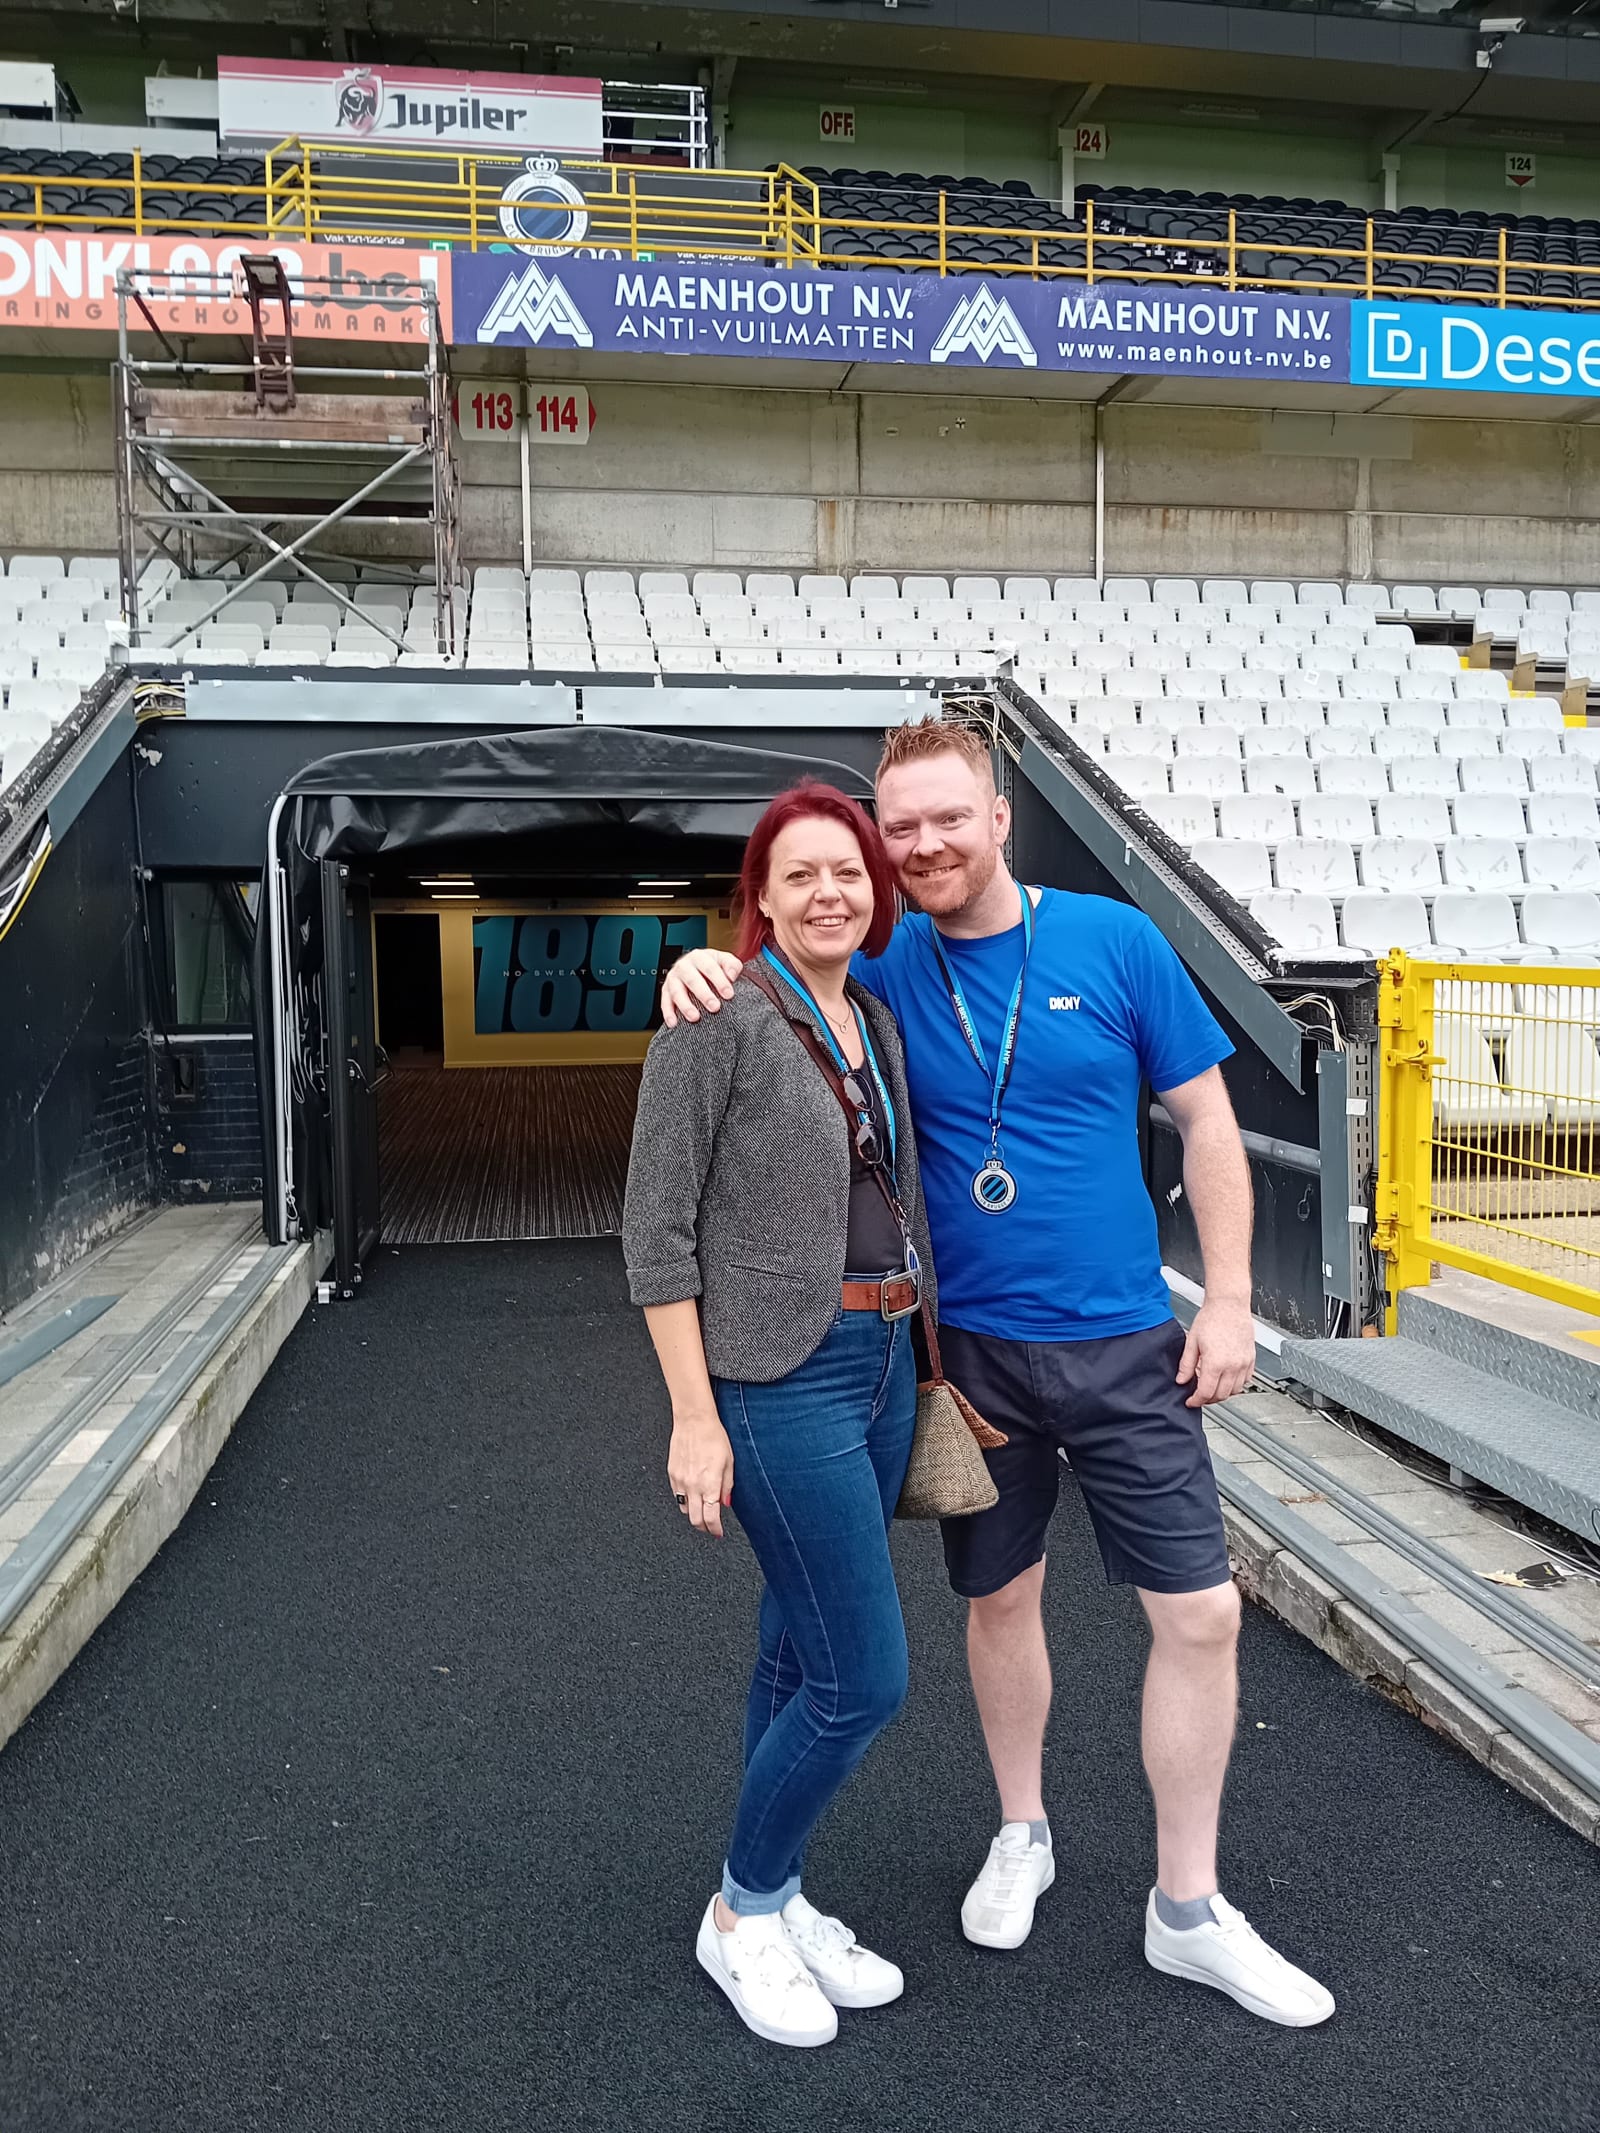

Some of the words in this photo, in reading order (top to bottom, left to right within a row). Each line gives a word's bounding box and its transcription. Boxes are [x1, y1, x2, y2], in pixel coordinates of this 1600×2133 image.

[384, 94, 527, 136] Jupiler
[1509, 157, 1532, 171] 124
[614, 273, 834, 315] MAENHOUT
[853, 285, 914, 319] N.V.
[616, 314, 914, 351] ANTI-VUILMATTEN
[1057, 297, 1259, 337] MAENHOUT
[1275, 308, 1332, 341] N.V.
[1057, 342, 1332, 370] www.maenhout-nv.be
[1442, 317, 1600, 387] Dese
[471, 392, 513, 430] 113
[536, 395, 579, 433] 114
[534, 969, 586, 977] SWEAT
[1048, 996, 1081, 1010] DKNY
[1005, 1014, 1017, 1050] BREYDEL
